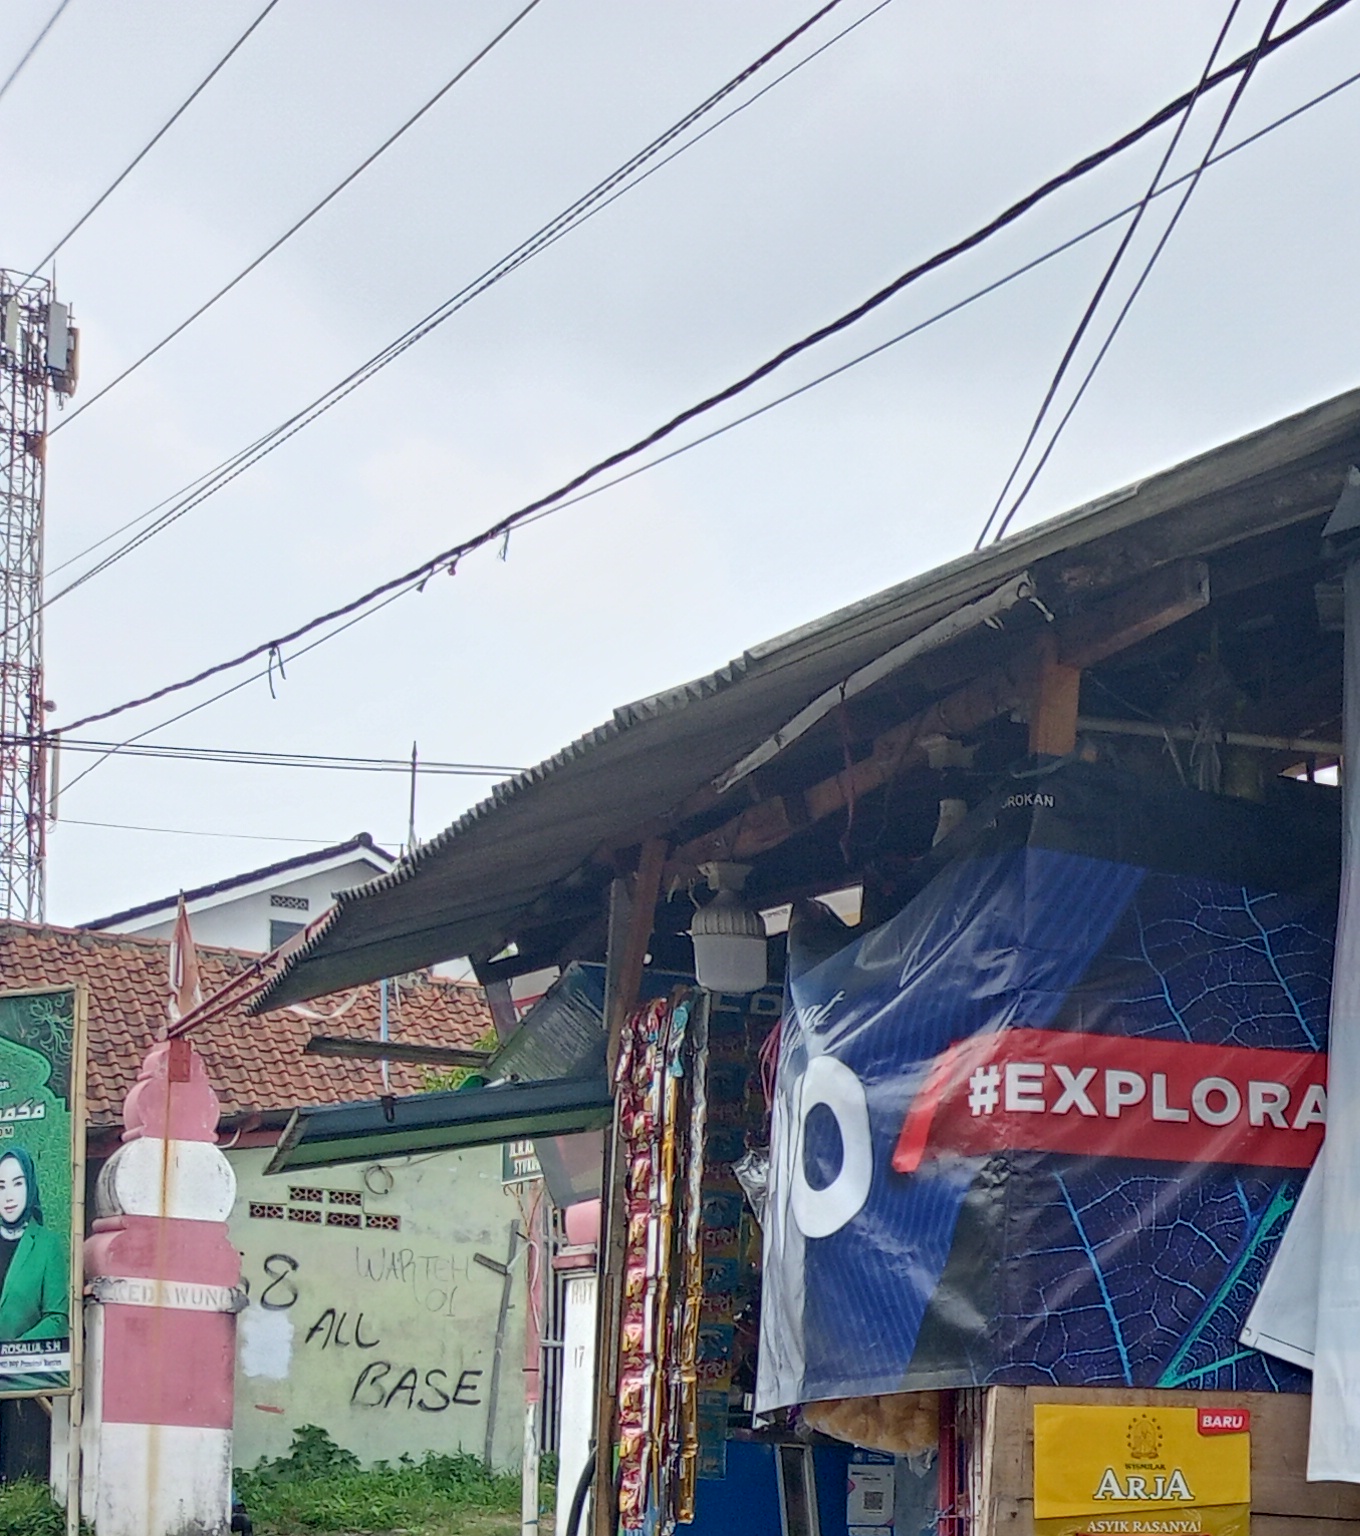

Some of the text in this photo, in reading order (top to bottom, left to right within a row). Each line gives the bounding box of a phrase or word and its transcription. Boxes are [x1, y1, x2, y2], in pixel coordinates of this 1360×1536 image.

[967, 1061, 1327, 1130] #EXPLORA
[305, 1308, 380, 1349] ALL
[351, 1361, 483, 1411] BASE
[1202, 1415, 1243, 1428] BARU
[1093, 1468, 1195, 1501] ARJA
[1087, 1521, 1129, 1533] ASYIK
